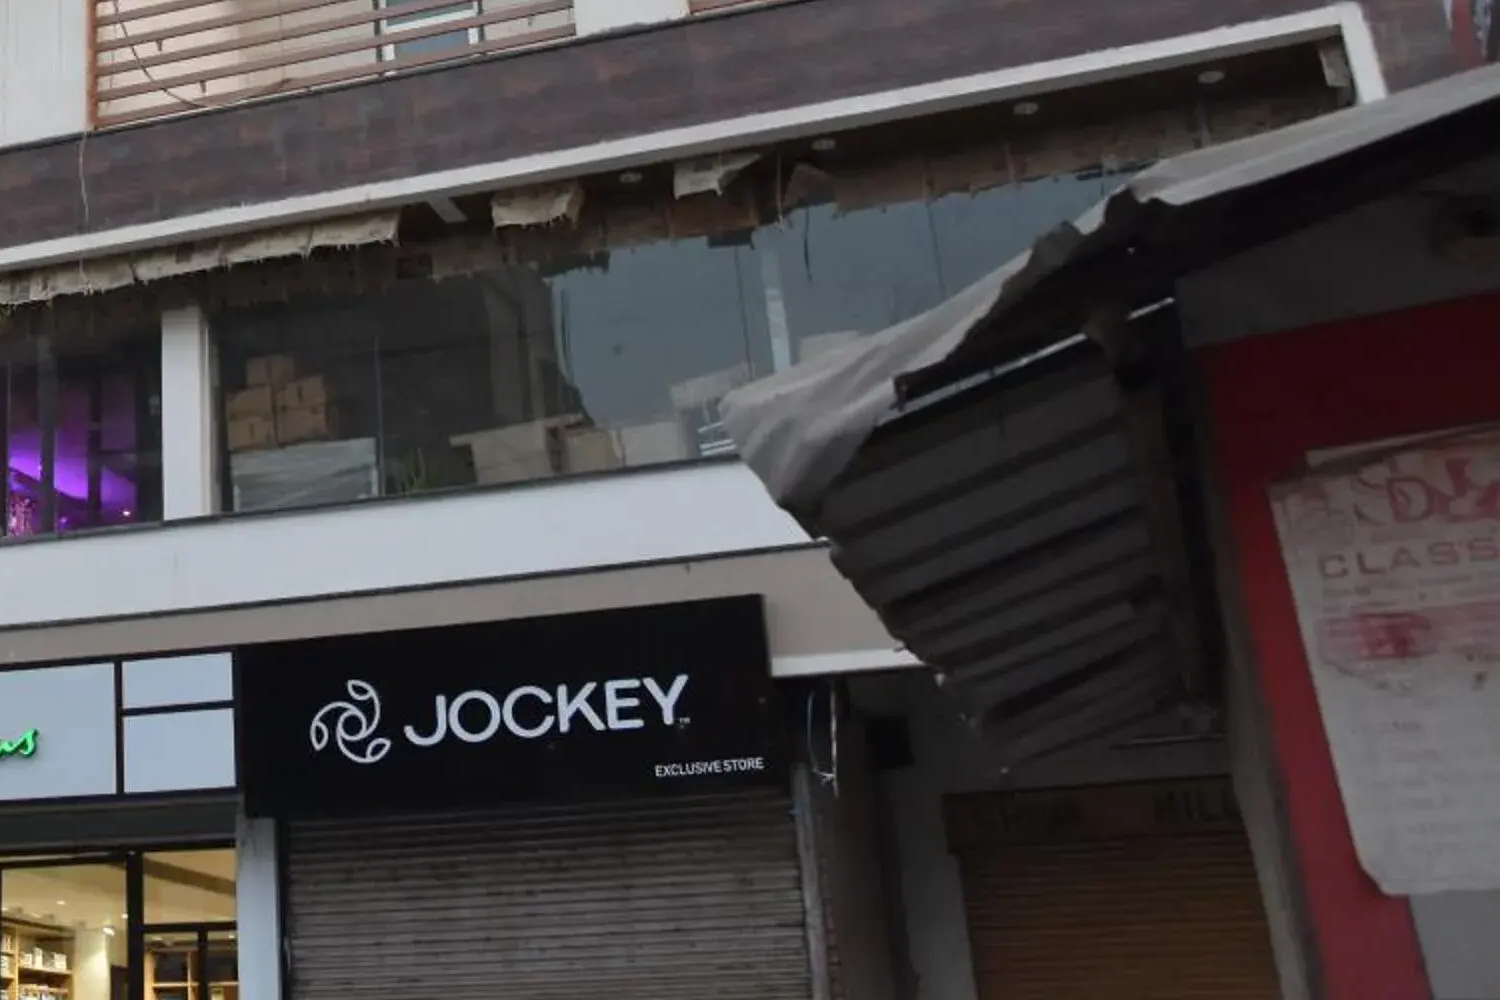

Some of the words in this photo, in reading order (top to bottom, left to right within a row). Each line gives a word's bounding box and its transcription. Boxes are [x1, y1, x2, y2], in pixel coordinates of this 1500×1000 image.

[404, 674, 689, 746] JOCKEY
[655, 760, 722, 777] EXCLUSIVE
[723, 757, 765, 772] STORE
